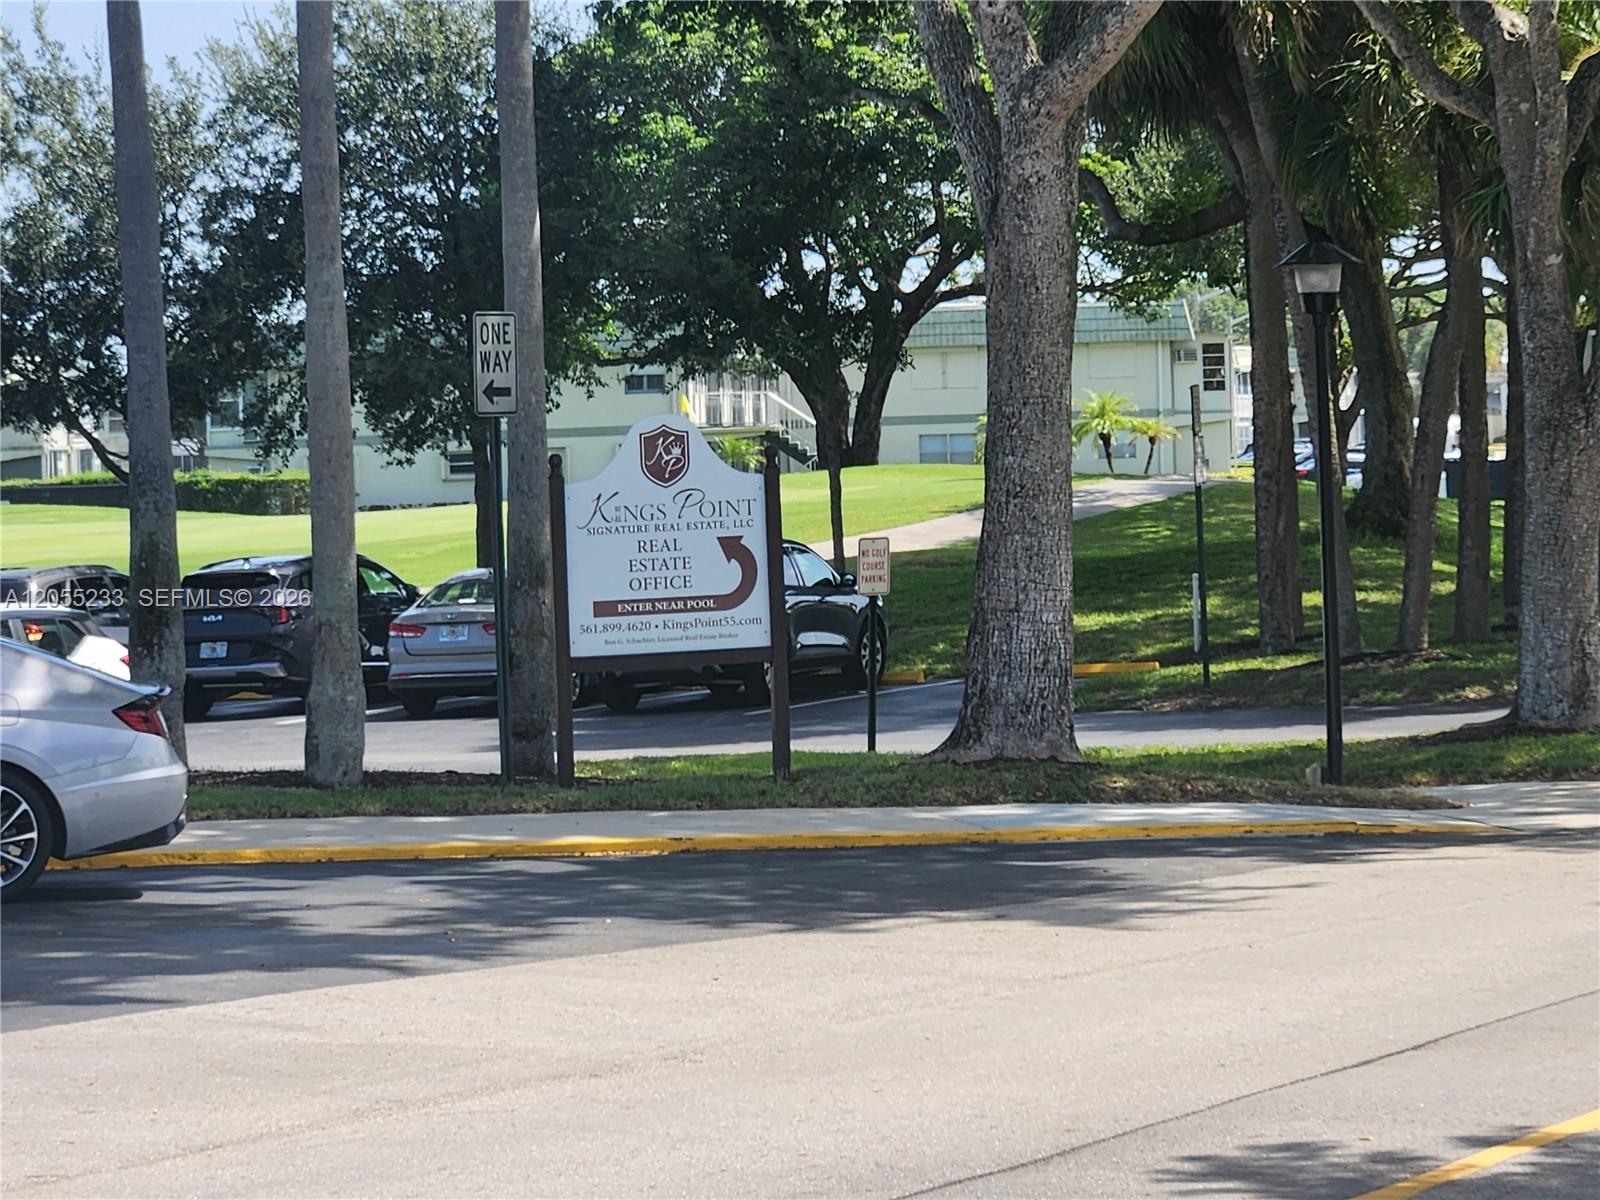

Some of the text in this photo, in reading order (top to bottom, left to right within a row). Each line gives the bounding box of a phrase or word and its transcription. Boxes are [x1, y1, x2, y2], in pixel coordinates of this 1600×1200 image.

[480, 322, 512, 345] ONE
[480, 350, 512, 374] WAY
[586, 518, 754, 536] SIGNATURE REAL ESTATE, LLC
[637, 538, 683, 553] REAL
[862, 548, 886, 558] NO GOLF
[628, 556, 692, 573] ESTATE
[862, 561, 885, 571] COURSE
[628, 574, 693, 592] OFFICE
[861, 574, 887, 584] PARKING
[617, 599, 717, 613] ENTER NEAR POOL
[579, 615, 763, 634] 561.899.4620 KingsPoint55.com
